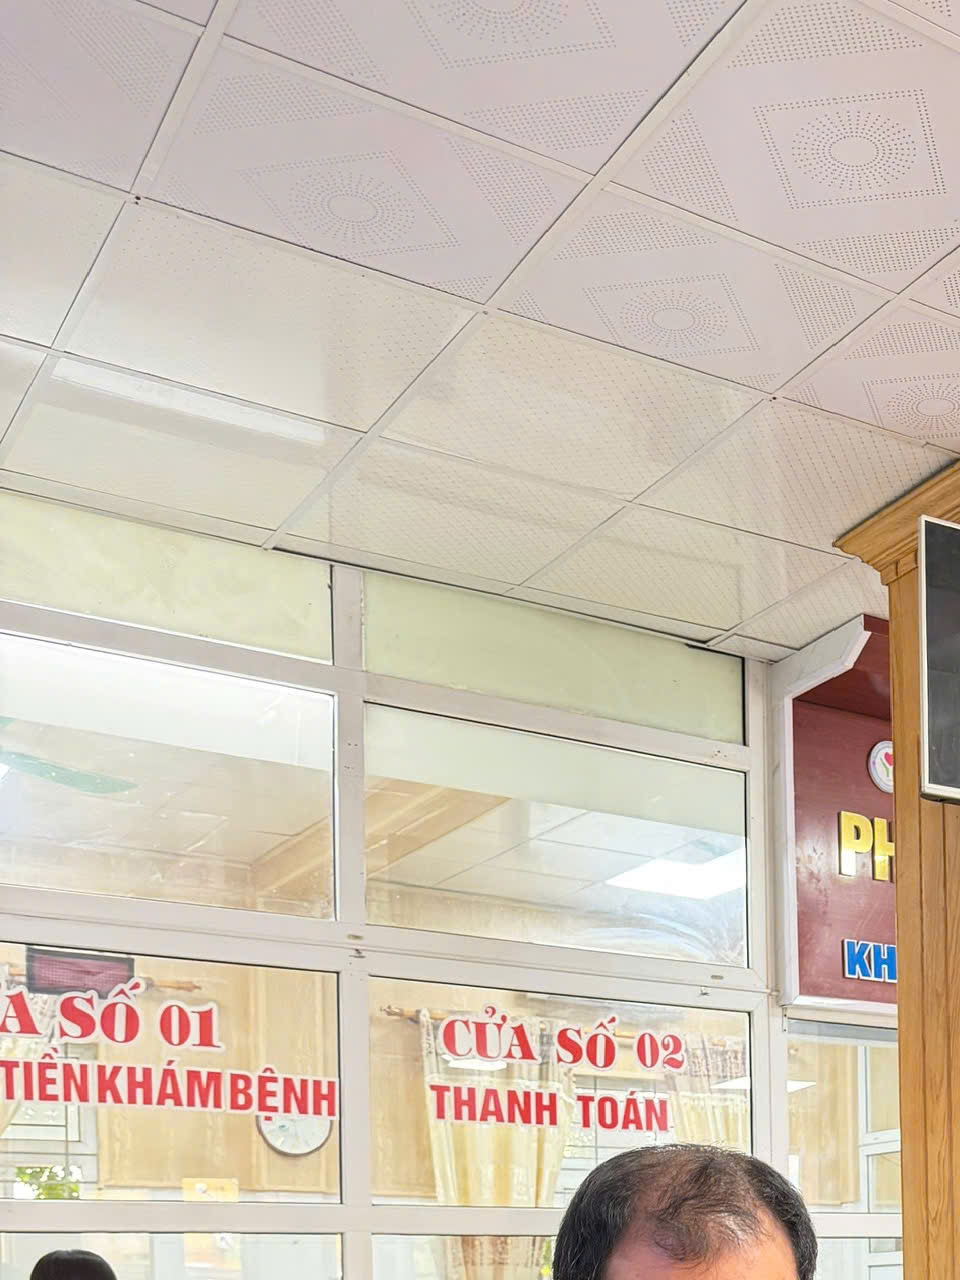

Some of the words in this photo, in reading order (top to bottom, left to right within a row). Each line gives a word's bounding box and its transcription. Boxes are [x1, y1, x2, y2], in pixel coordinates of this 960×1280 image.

[59, 981, 141, 1043] SỐ
[160, 1003, 221, 1048] 01
[443, 1006, 537, 1061] CỬA
[557, 1016, 616, 1068] SỐ
[637, 1033, 685, 1069] 02
[0, 1047, 90, 1102] TIỀN
[97, 1060, 222, 1109] KHÁM
[230, 1067, 336, 1121] BỆNH
[429, 1085, 557, 1126] THANH
[577, 1090, 668, 1132] TOÁN
